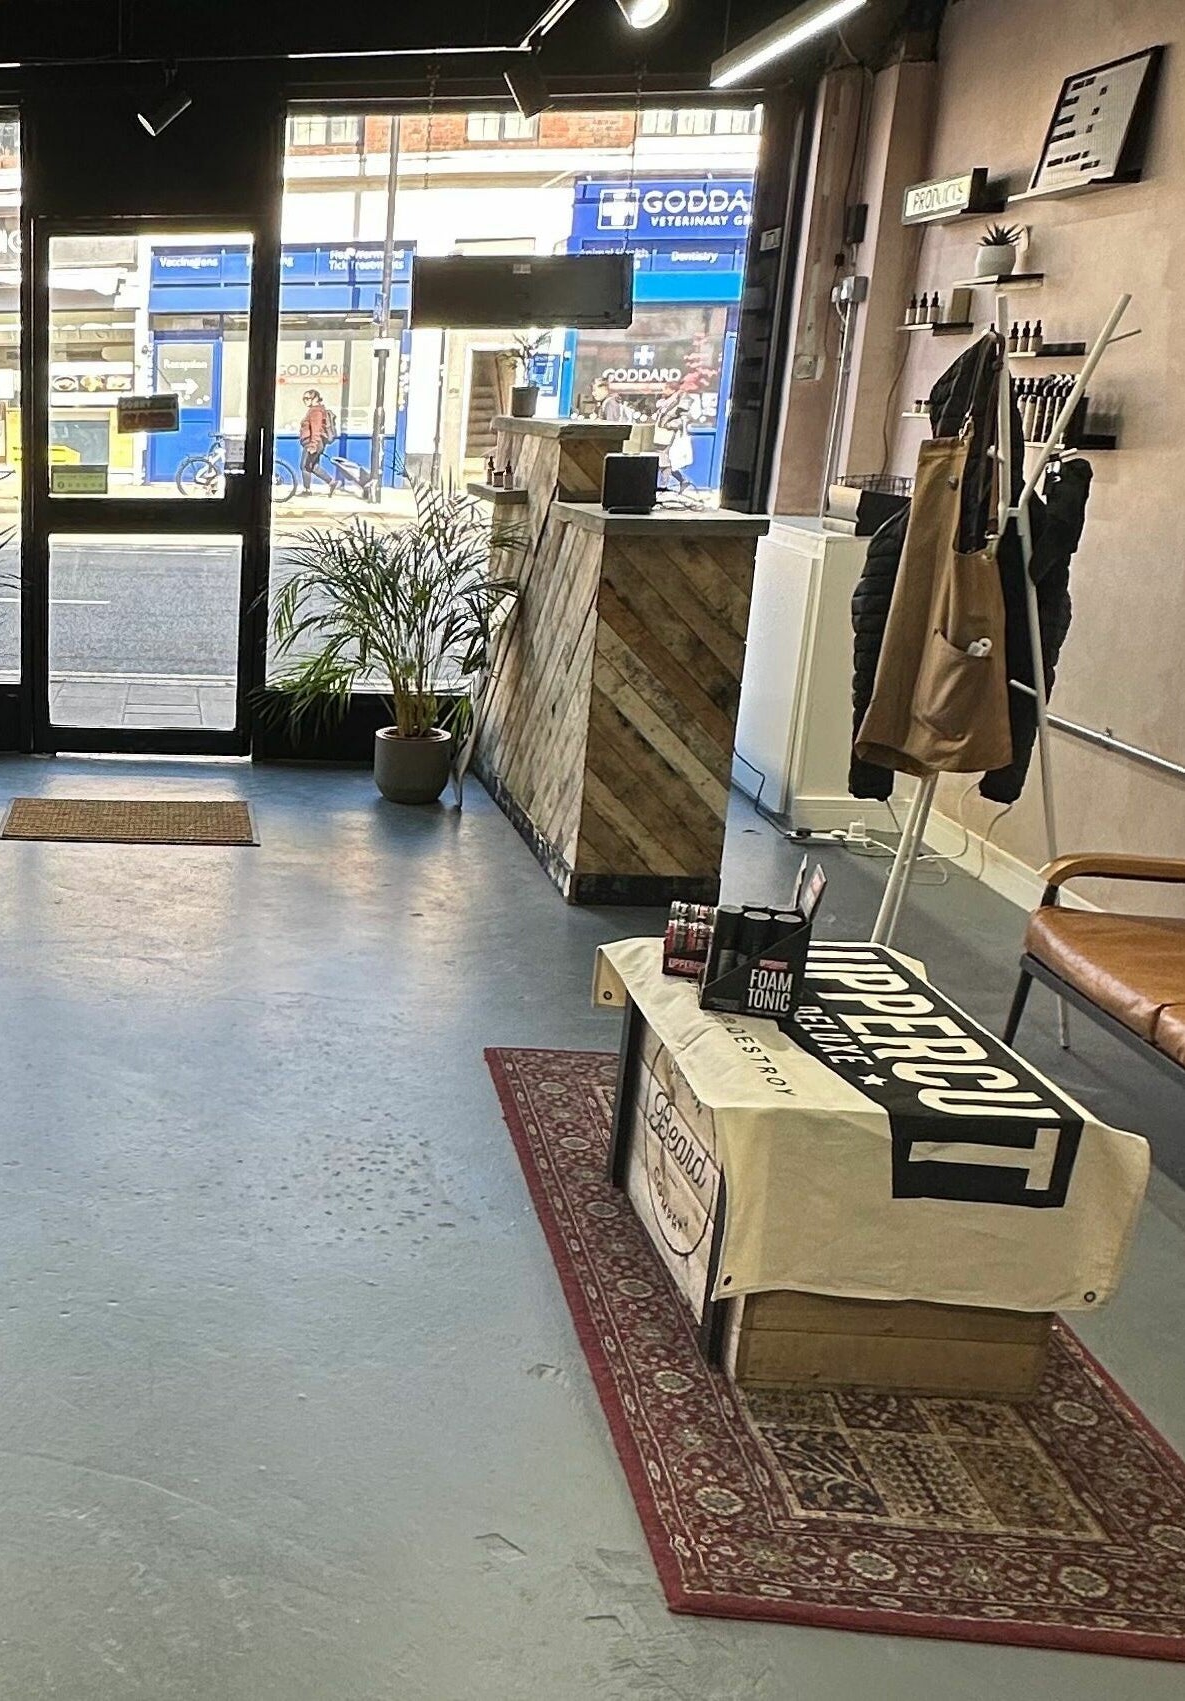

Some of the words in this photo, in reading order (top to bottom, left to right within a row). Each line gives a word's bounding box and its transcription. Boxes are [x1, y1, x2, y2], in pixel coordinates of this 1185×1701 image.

[913, 181, 964, 211] PRODUCTS
[651, 215, 729, 227] VETERINARY
[602, 368, 682, 383] GODDARD
[750, 969, 794, 992] FOAM
[748, 988, 791, 1012] TONIC
[794, 1005, 875, 1064] DELUXE
[726, 1027, 798, 1096] DESTROY
[805, 941, 1061, 1190] UPPERCUT
[649, 1091, 709, 1189] Beard
